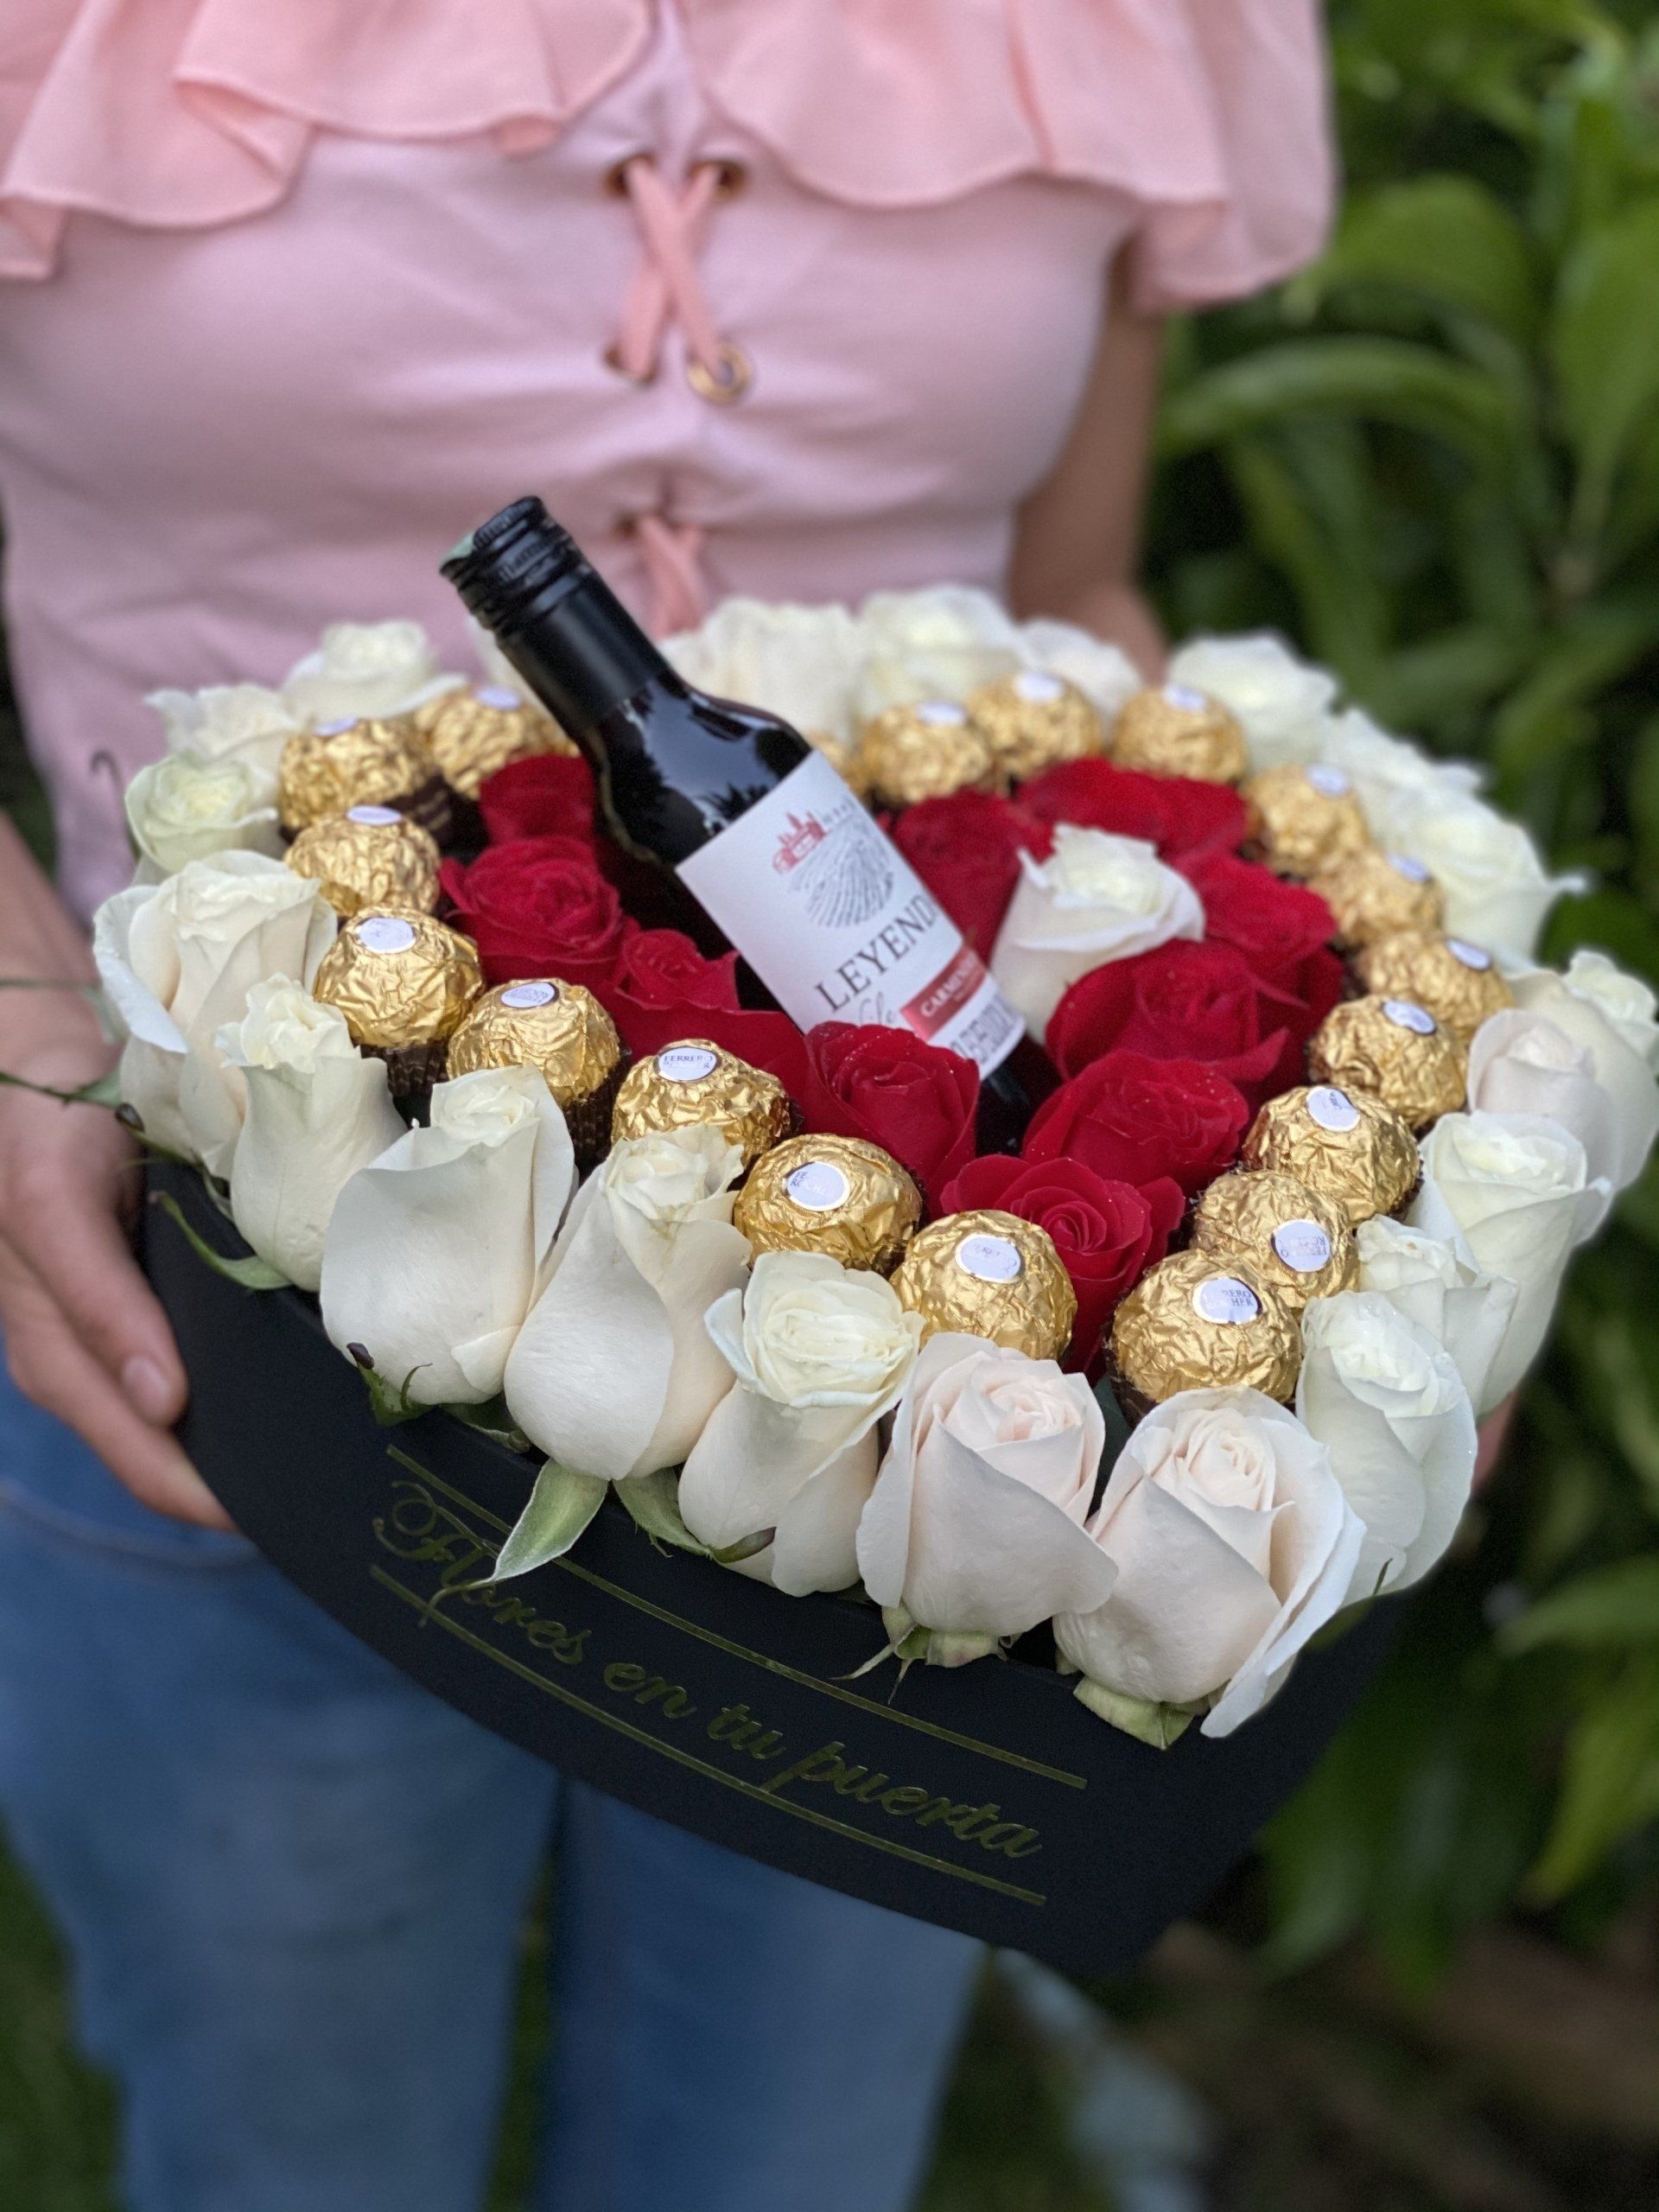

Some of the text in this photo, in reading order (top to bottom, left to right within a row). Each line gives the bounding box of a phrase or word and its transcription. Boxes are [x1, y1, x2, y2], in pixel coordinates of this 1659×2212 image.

[604, 1662, 697, 1719] en
[706, 1703, 785, 1760] tu
[757, 1740, 1043, 1859] puerta
